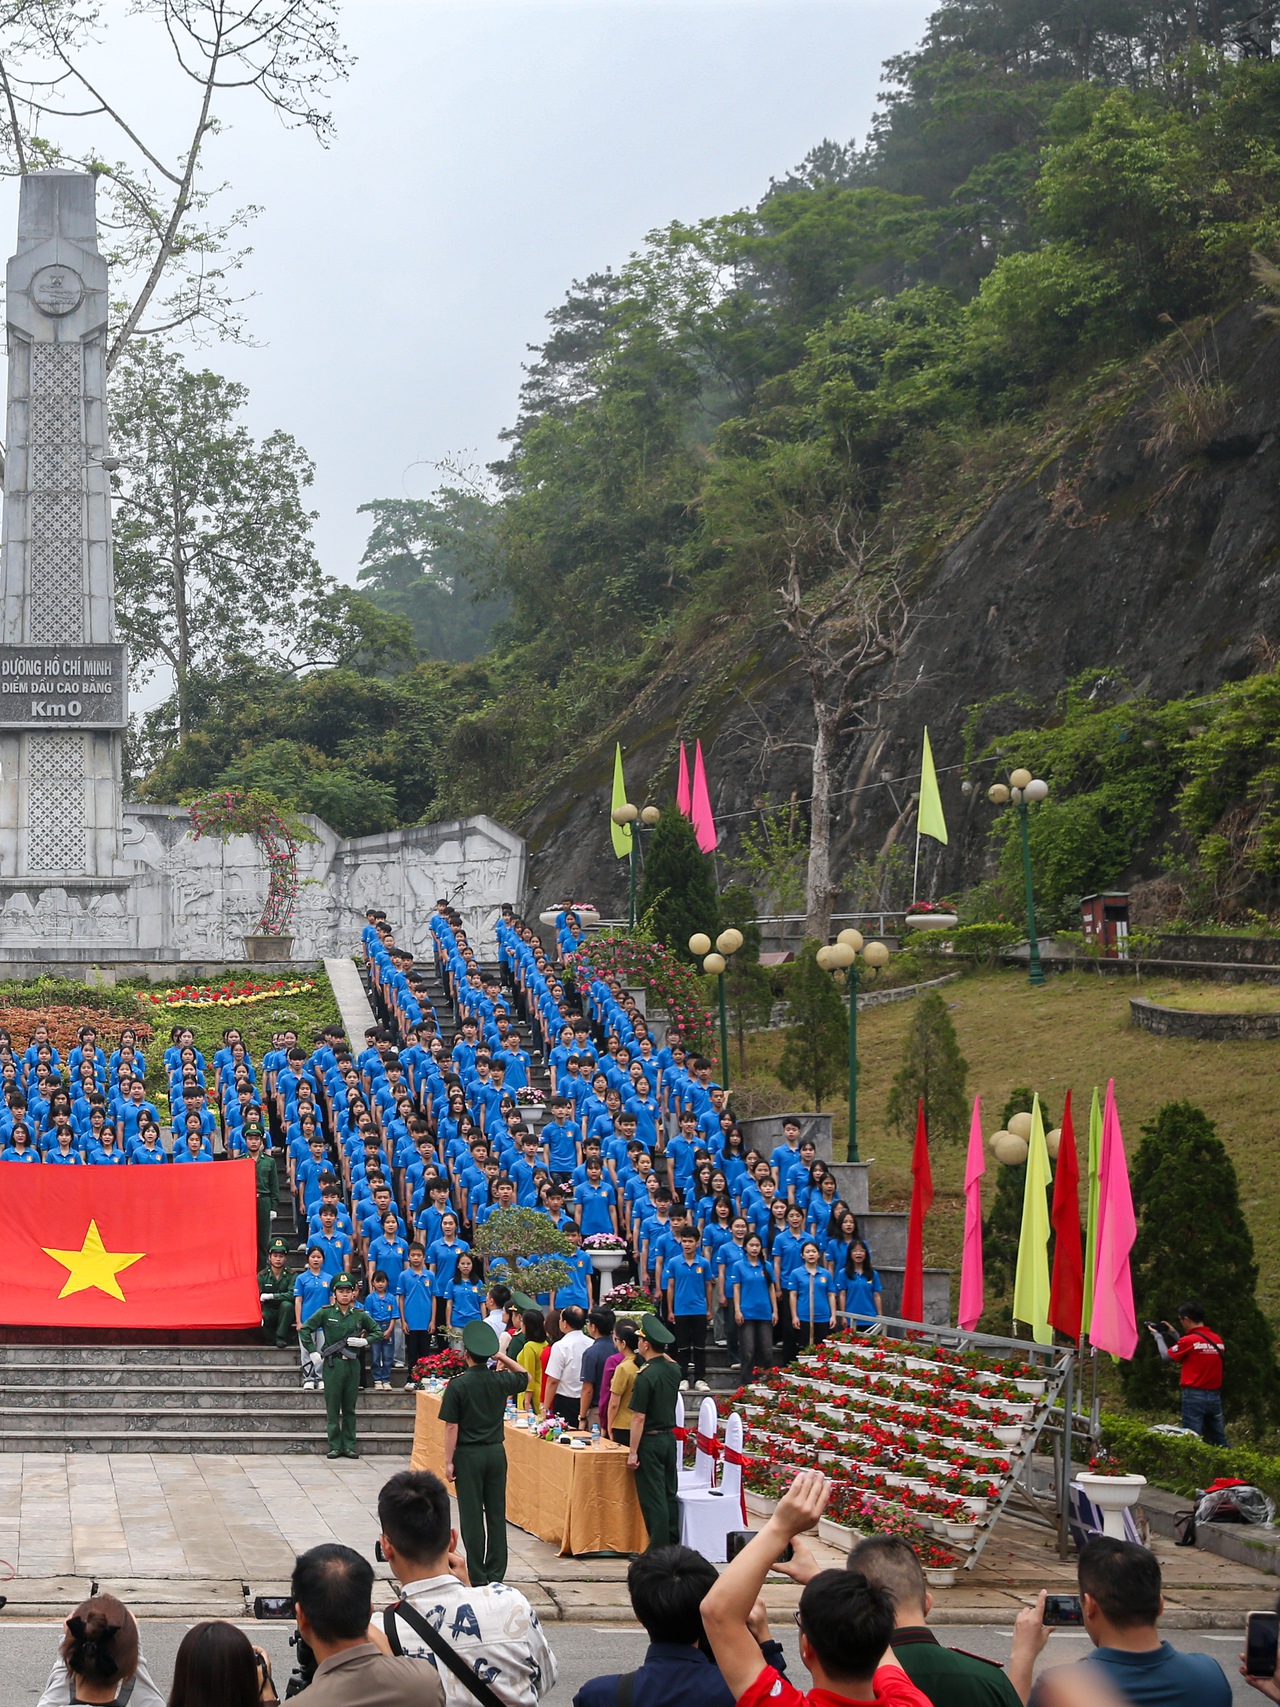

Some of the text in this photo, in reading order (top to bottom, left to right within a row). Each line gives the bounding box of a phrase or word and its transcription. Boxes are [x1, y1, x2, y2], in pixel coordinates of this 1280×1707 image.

[1, 653, 112, 676] ĐƯỜNG HỒ CHÍ MINH
[1, 676, 28, 693] ĐIỂM
[31, 677, 54, 693] ĐẦU
[57, 682, 79, 693] CAO
